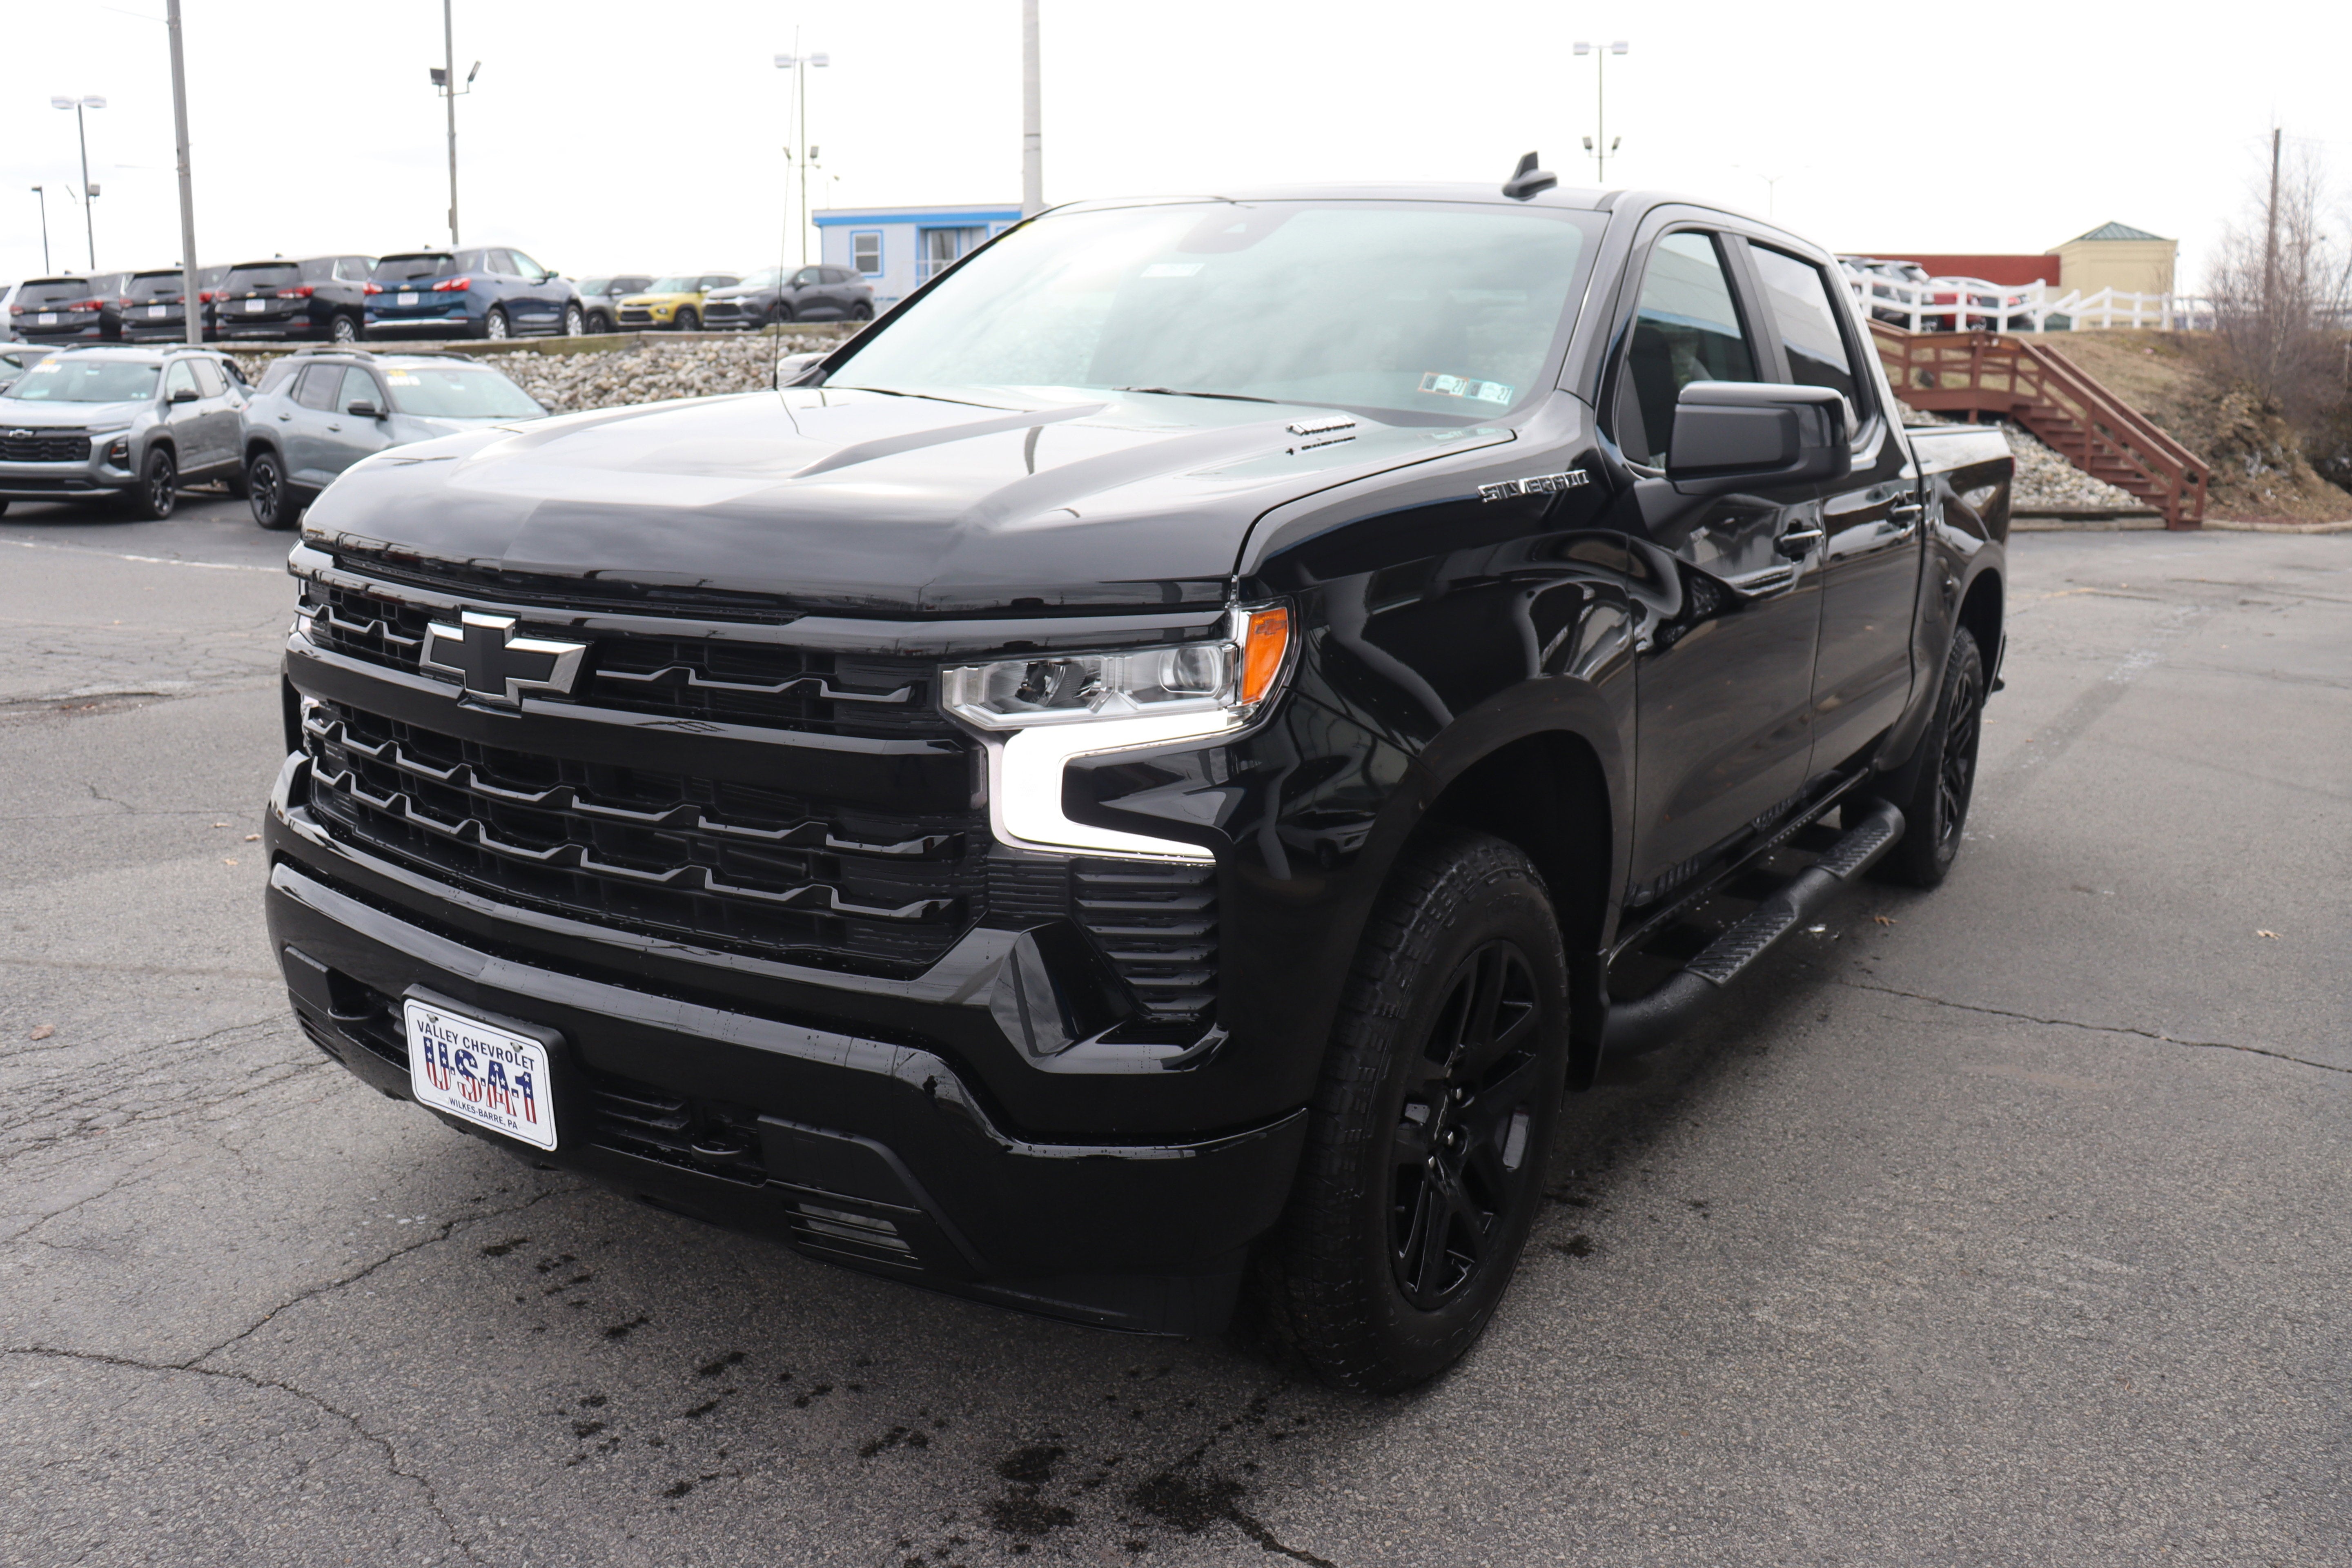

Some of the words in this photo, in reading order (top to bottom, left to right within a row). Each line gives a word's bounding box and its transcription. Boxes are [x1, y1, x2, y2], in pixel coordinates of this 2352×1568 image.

[417, 1020, 458, 1045] VALLEY
[463, 1036, 535, 1071] CHEVROLET
[449, 1097, 506, 1127] WILKES-BARRE,
[508, 1119, 518, 1129] PA
